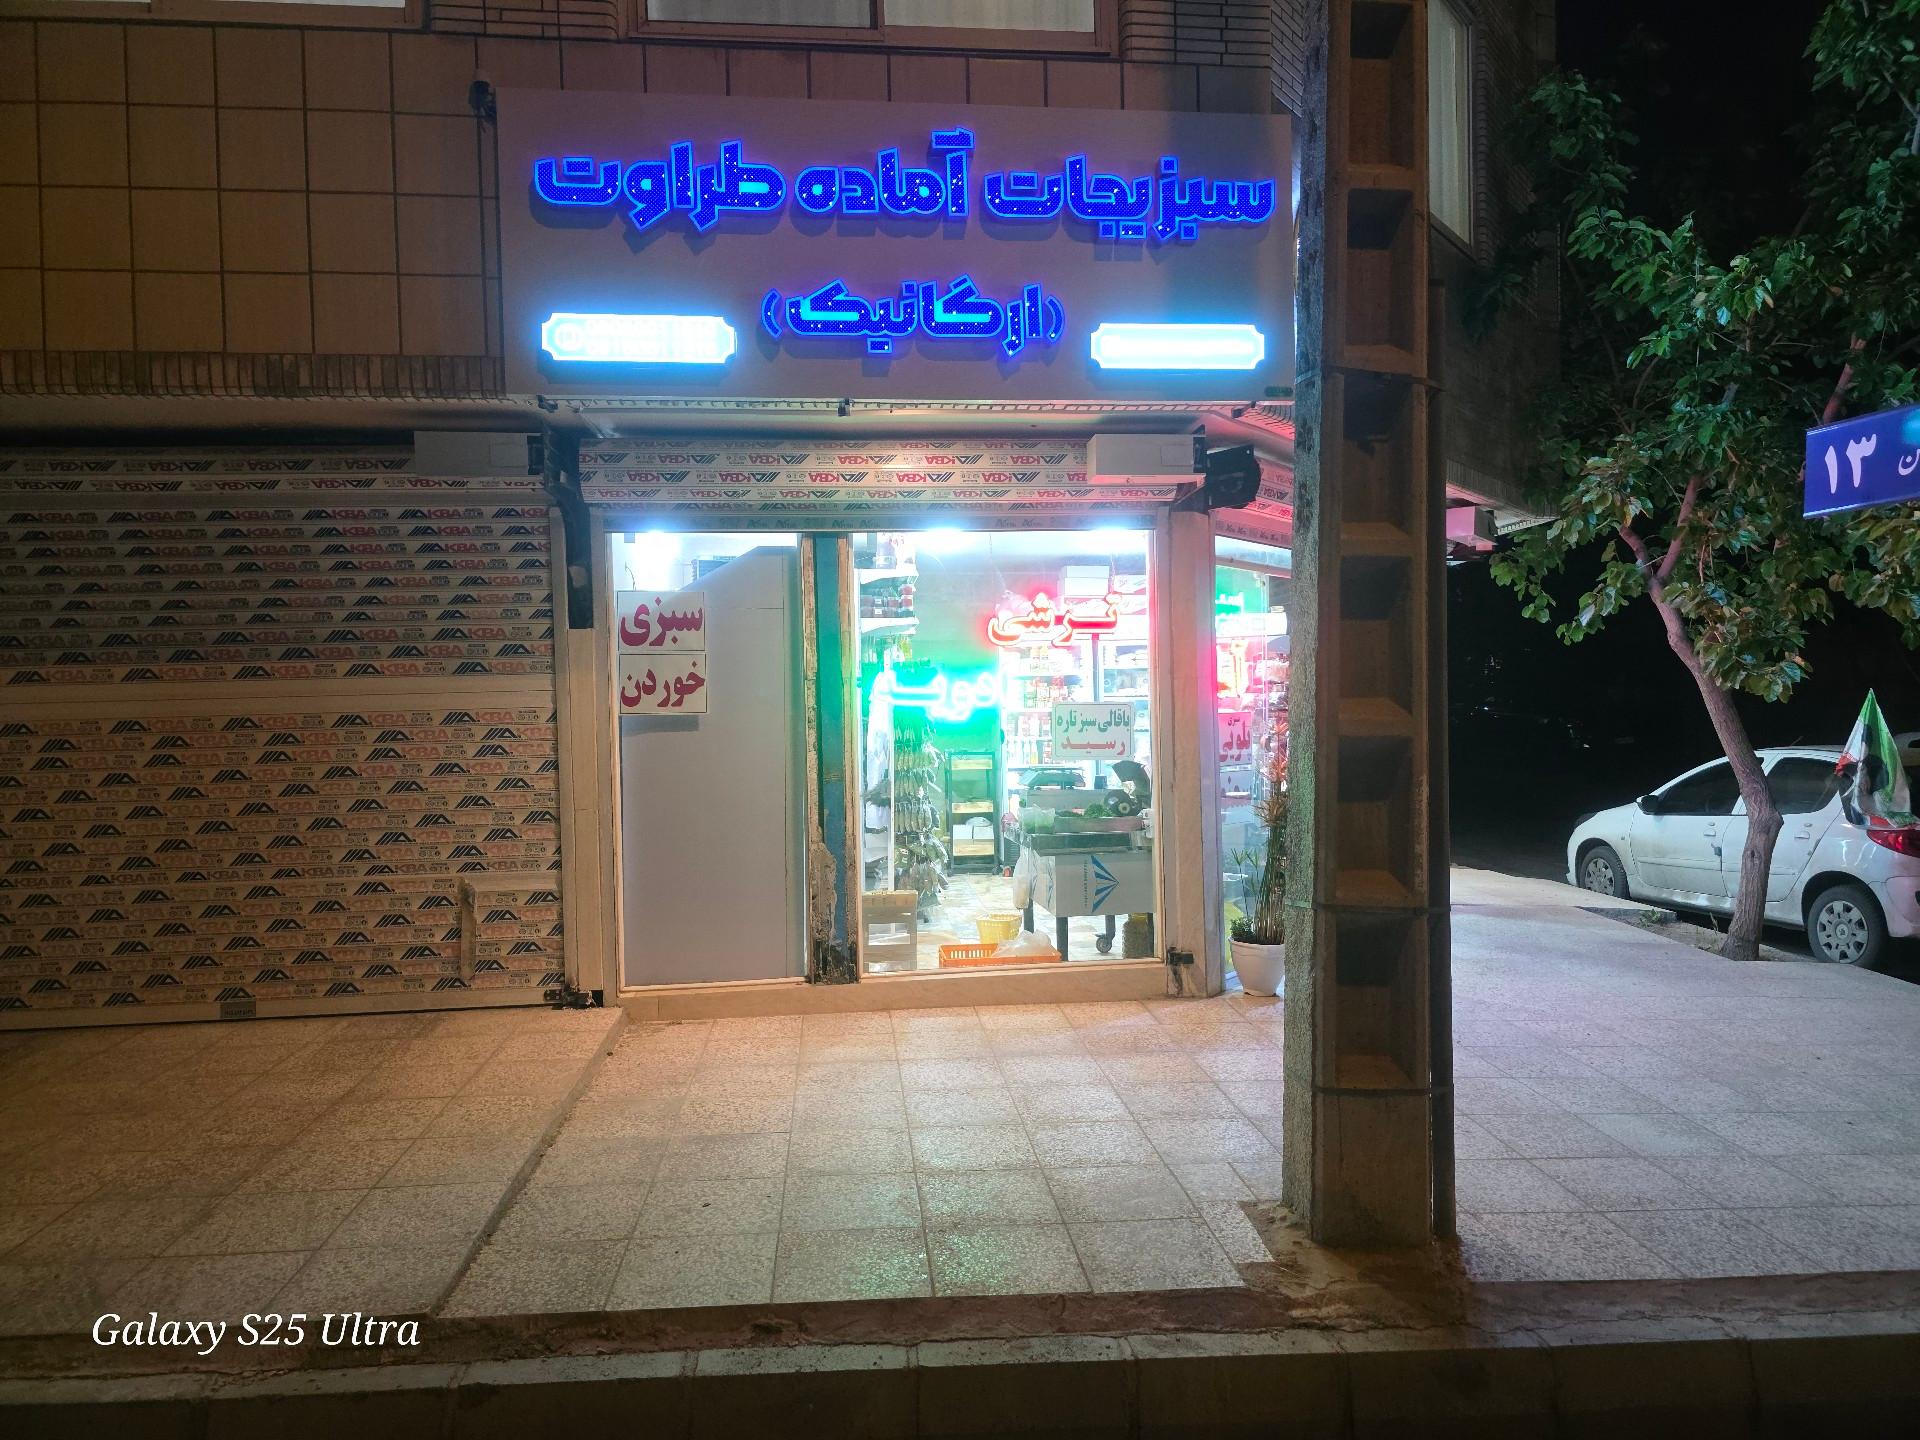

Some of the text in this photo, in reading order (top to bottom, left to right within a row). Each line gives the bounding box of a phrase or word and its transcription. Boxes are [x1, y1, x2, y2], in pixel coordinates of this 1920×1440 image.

[535, 127, 1275, 240] سبزیجات آماده طراوت
[1825, 433, 1877, 494] ۱۳
[620, 597, 703, 646] سبزی
[988, 592, 1122, 648] ترشی
[620, 661, 705, 707] خوردن
[1061, 736, 1126, 755] رسید
